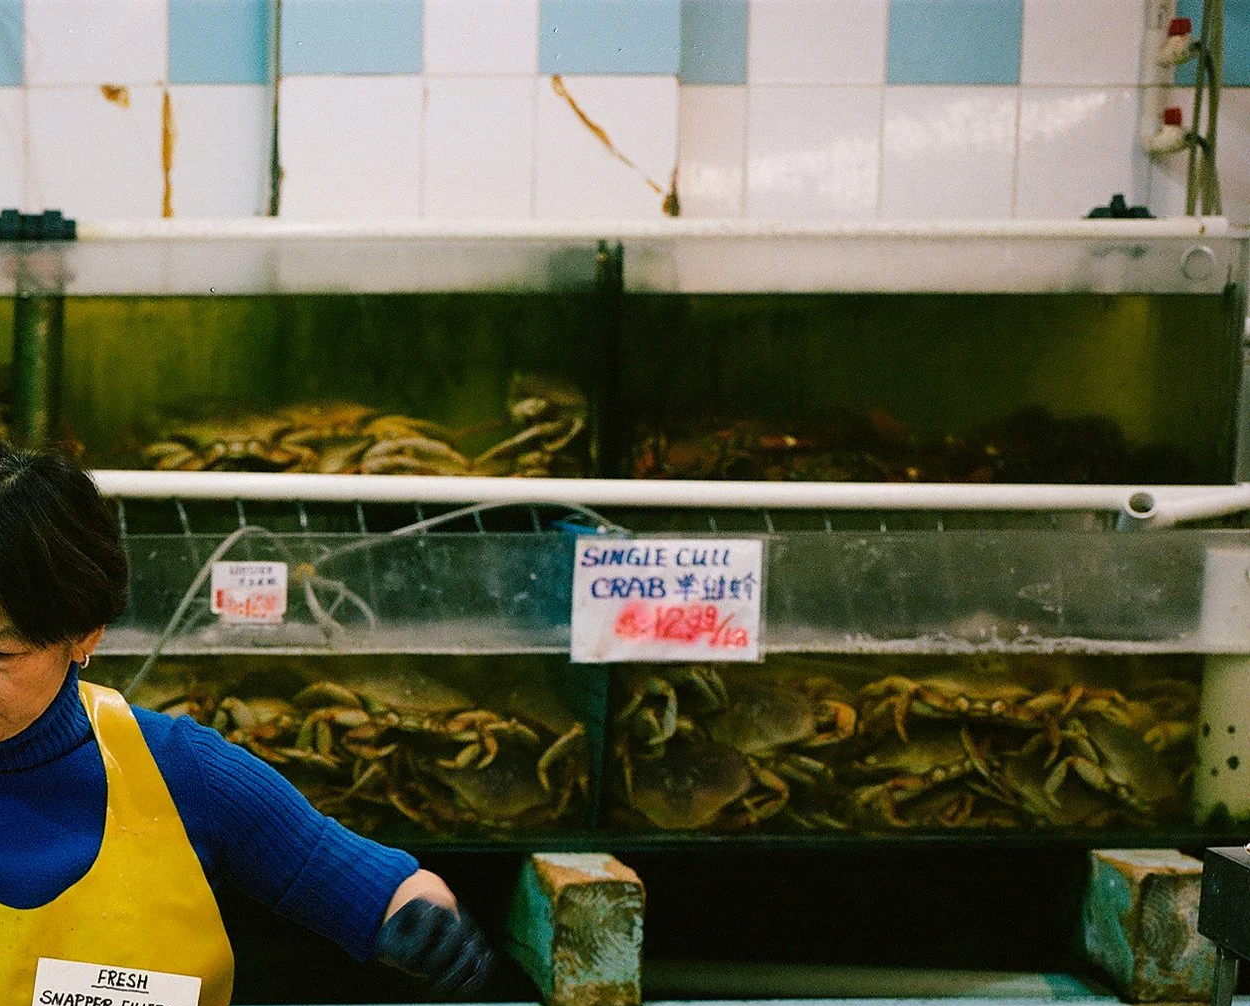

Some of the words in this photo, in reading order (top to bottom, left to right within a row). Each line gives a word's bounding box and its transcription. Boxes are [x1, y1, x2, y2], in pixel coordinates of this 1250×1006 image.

[581, 547, 667, 568] SINGLE
[591, 576, 667, 599] CRAB
[97, 968, 149, 990] FRESH
